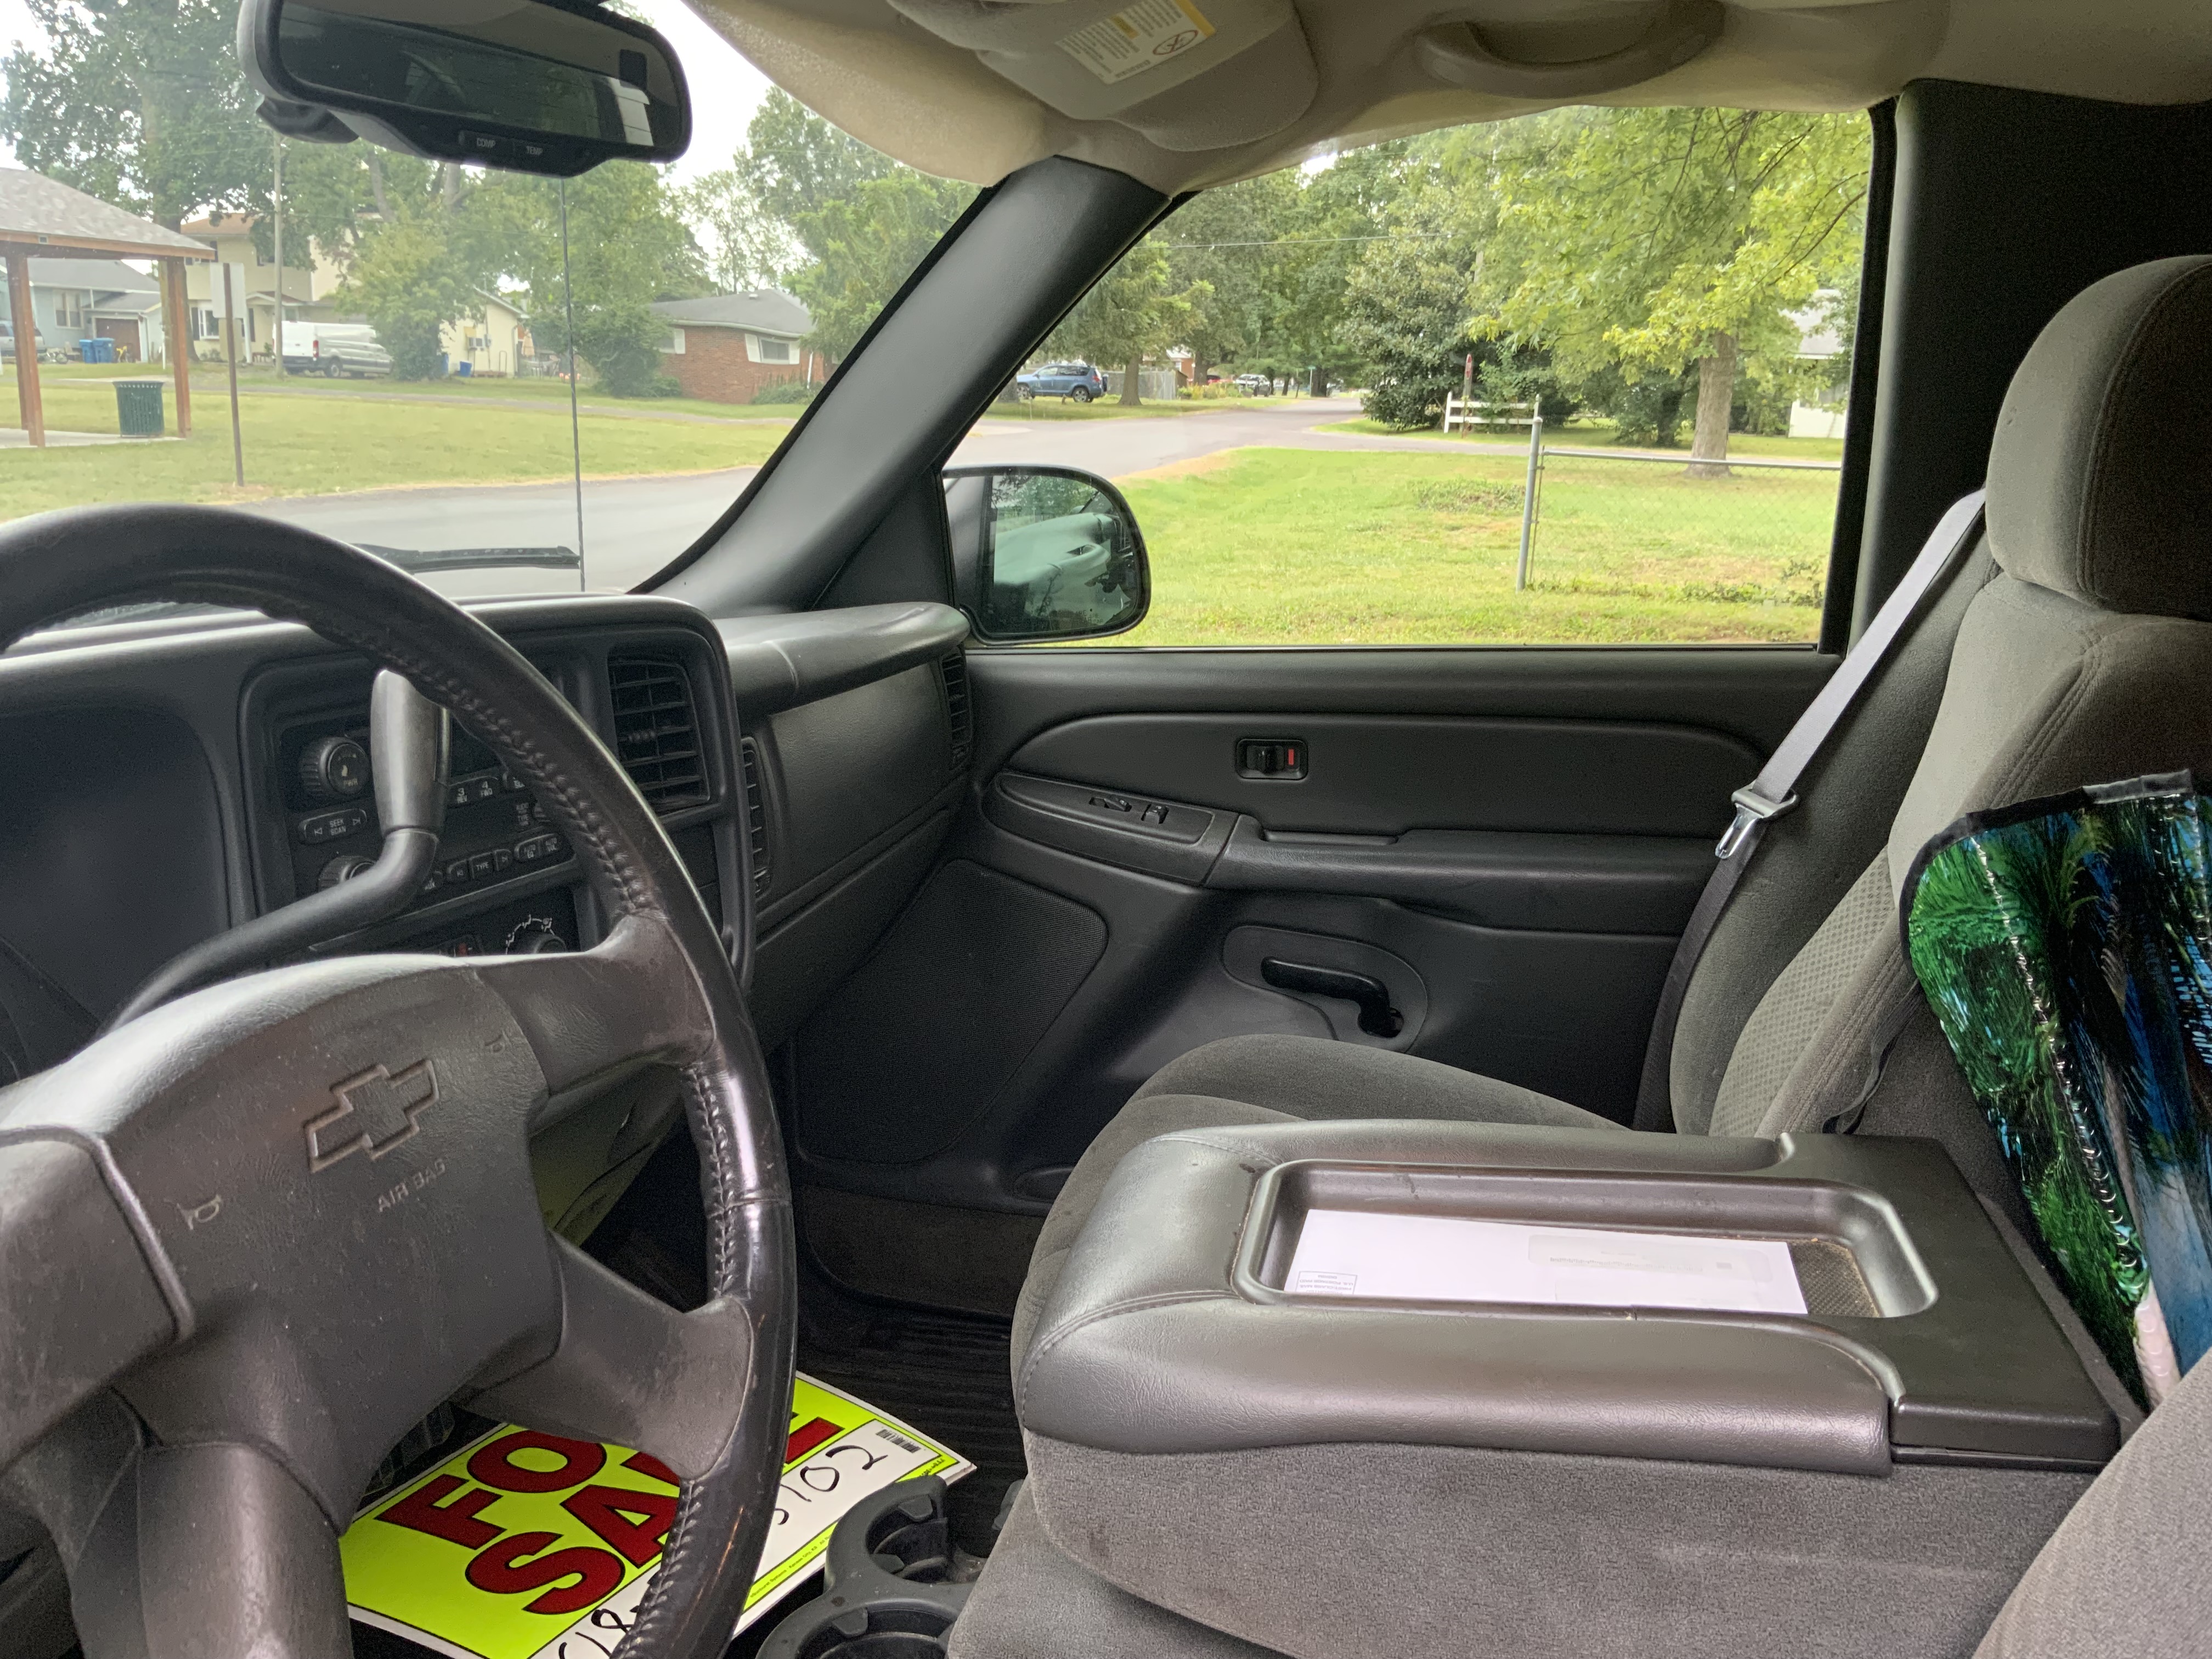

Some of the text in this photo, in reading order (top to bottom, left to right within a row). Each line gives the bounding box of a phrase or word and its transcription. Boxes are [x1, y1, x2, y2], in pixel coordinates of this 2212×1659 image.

[476, 138, 495, 148] COMP
[526, 145, 543, 156] TEMP
[482, 781, 488, 789] 4
[458, 787, 465, 796] 3
[329, 818, 345, 828] SEEK
[330, 826, 346, 836] SCAN
[475, 861, 489, 870] TYPE
[377, 1159, 446, 1212] AIR BAG
[374, 1429, 607, 1550] FO
